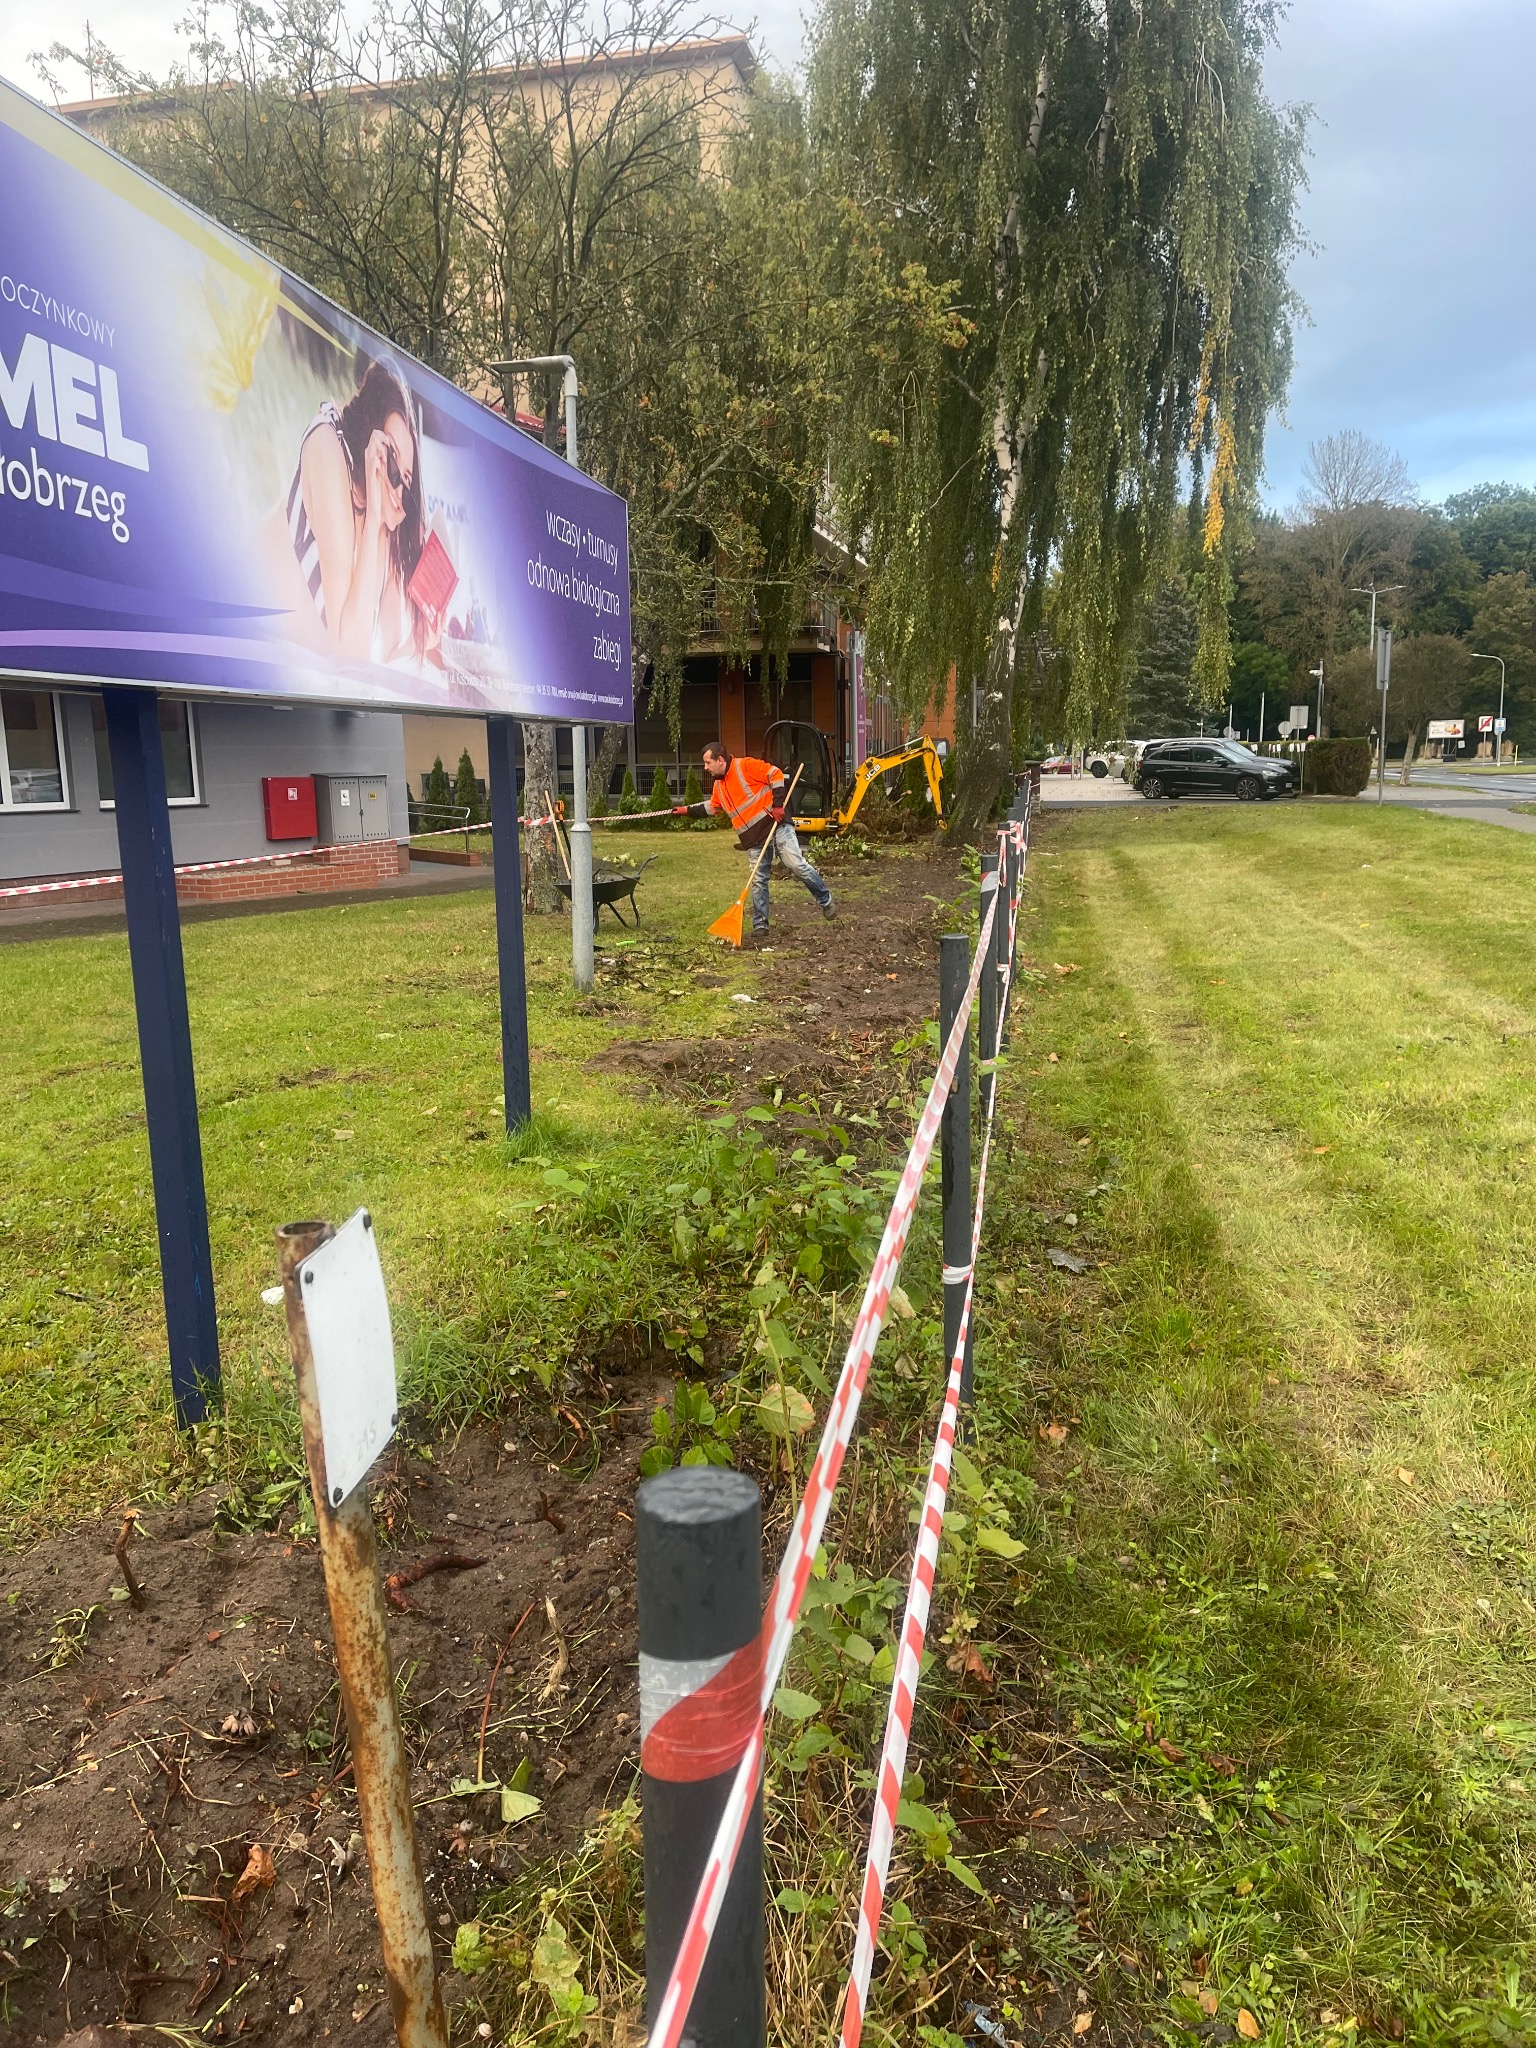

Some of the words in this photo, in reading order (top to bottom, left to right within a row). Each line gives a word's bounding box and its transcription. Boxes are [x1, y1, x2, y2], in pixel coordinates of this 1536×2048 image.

[1, 275, 115, 348] OCZYNKOWY
[0, 332, 149, 472] MEL
[546, 510, 581, 558] wczasy
[587, 528, 619, 575] turnusy
[527, 552, 570, 598] odnowa
[572, 567, 619, 617] biologiczna
[593, 629, 622, 671] zabiegi
[866, 764, 881, 780] JCB
